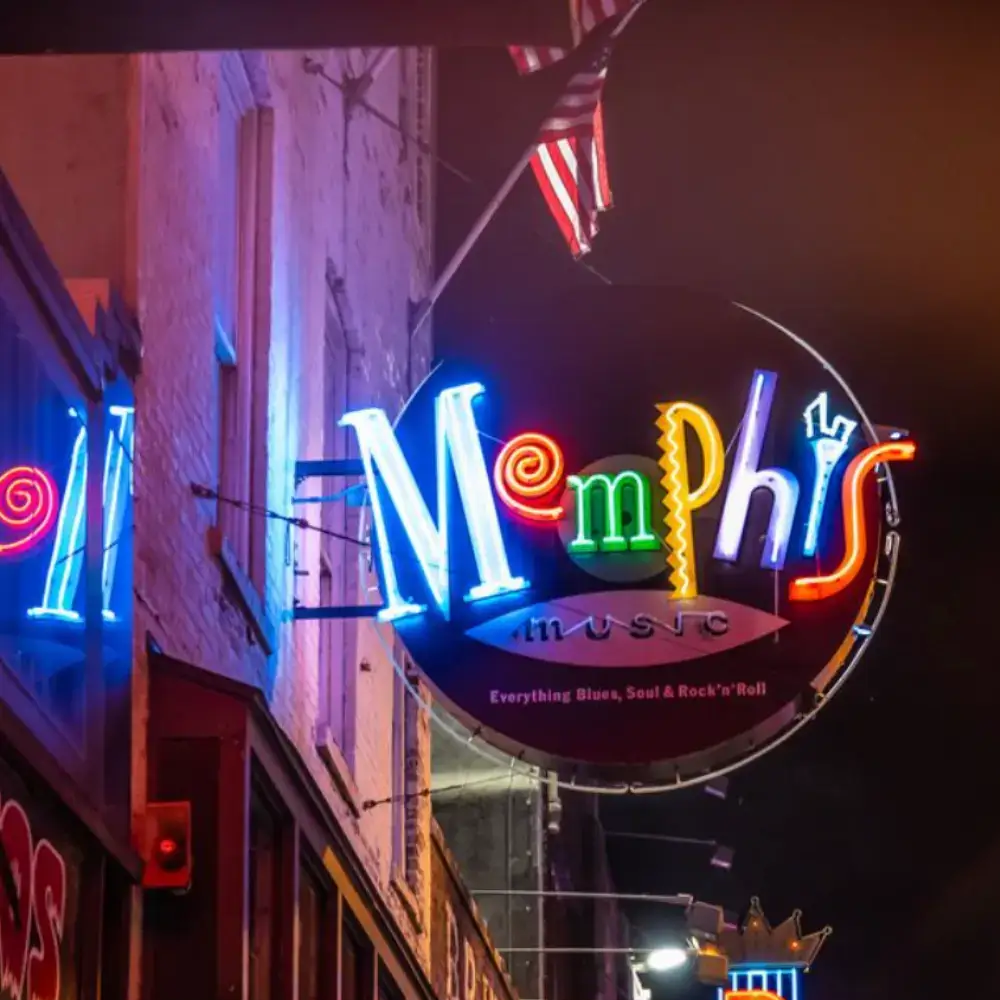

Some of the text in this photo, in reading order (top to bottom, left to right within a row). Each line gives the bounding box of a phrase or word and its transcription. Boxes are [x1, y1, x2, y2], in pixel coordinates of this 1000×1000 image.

[524, 609, 730, 642] music
[489, 690, 571, 705] Everything
[576, 687, 622, 703] Blues,
[627, 685, 660, 700] Soul
[662, 685, 675, 699] &
